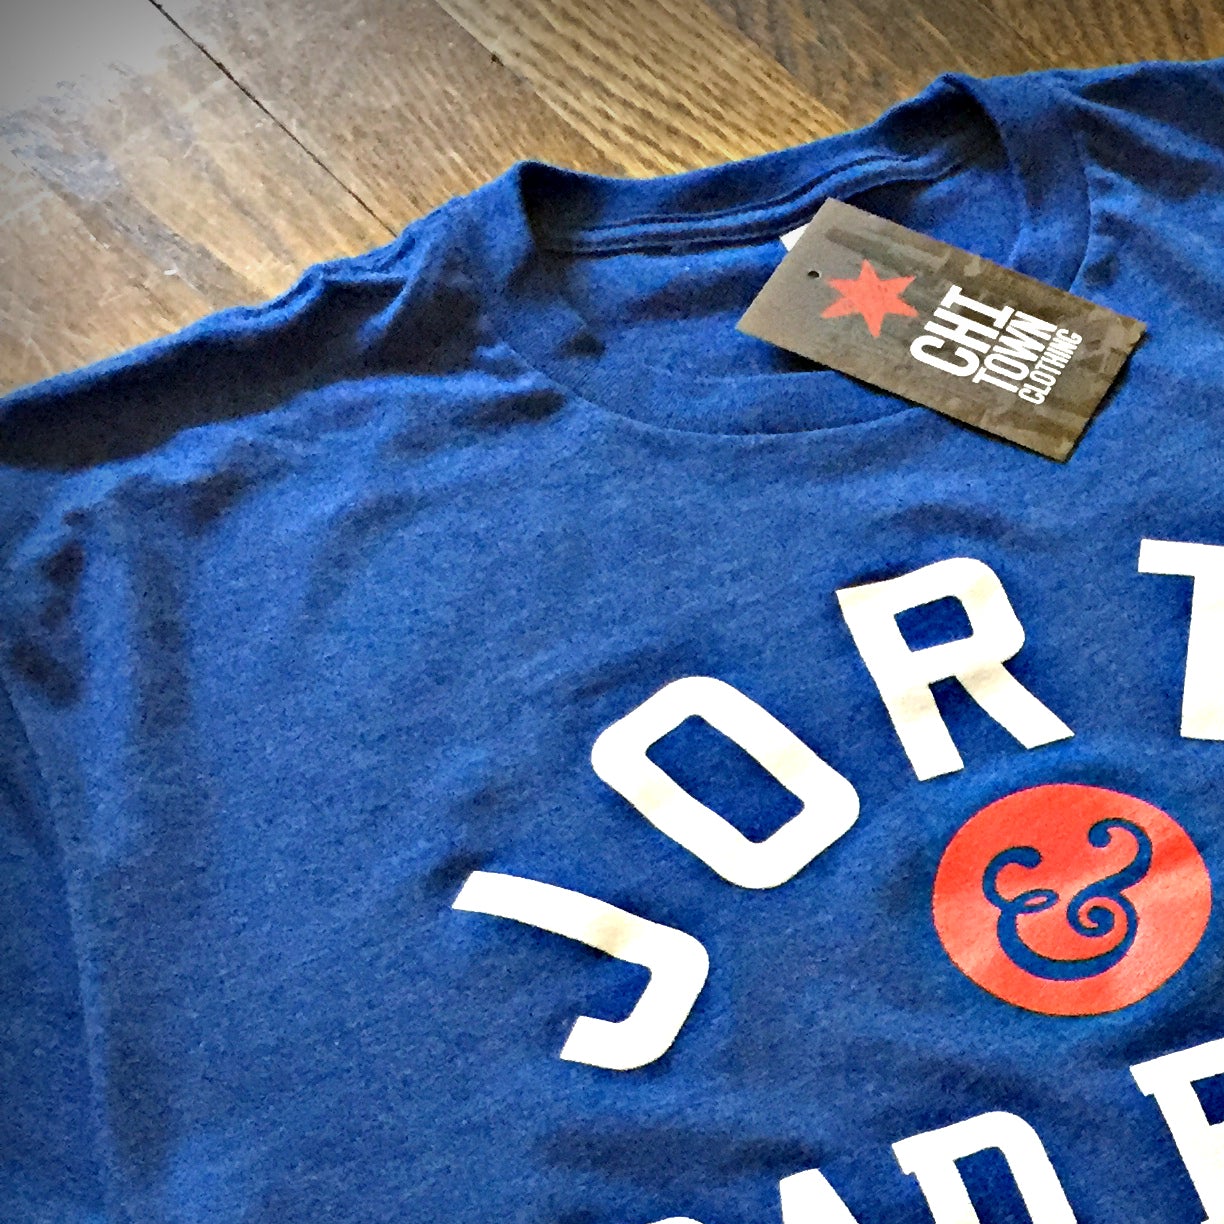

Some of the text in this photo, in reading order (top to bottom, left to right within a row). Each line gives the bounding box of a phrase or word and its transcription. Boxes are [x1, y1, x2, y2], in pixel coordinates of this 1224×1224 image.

[910, 285, 1015, 377] CHI
[972, 311, 1057, 393] TOWN
[1018, 328, 1083, 405] CLOTHING
[982, 817, 1153, 982] &
